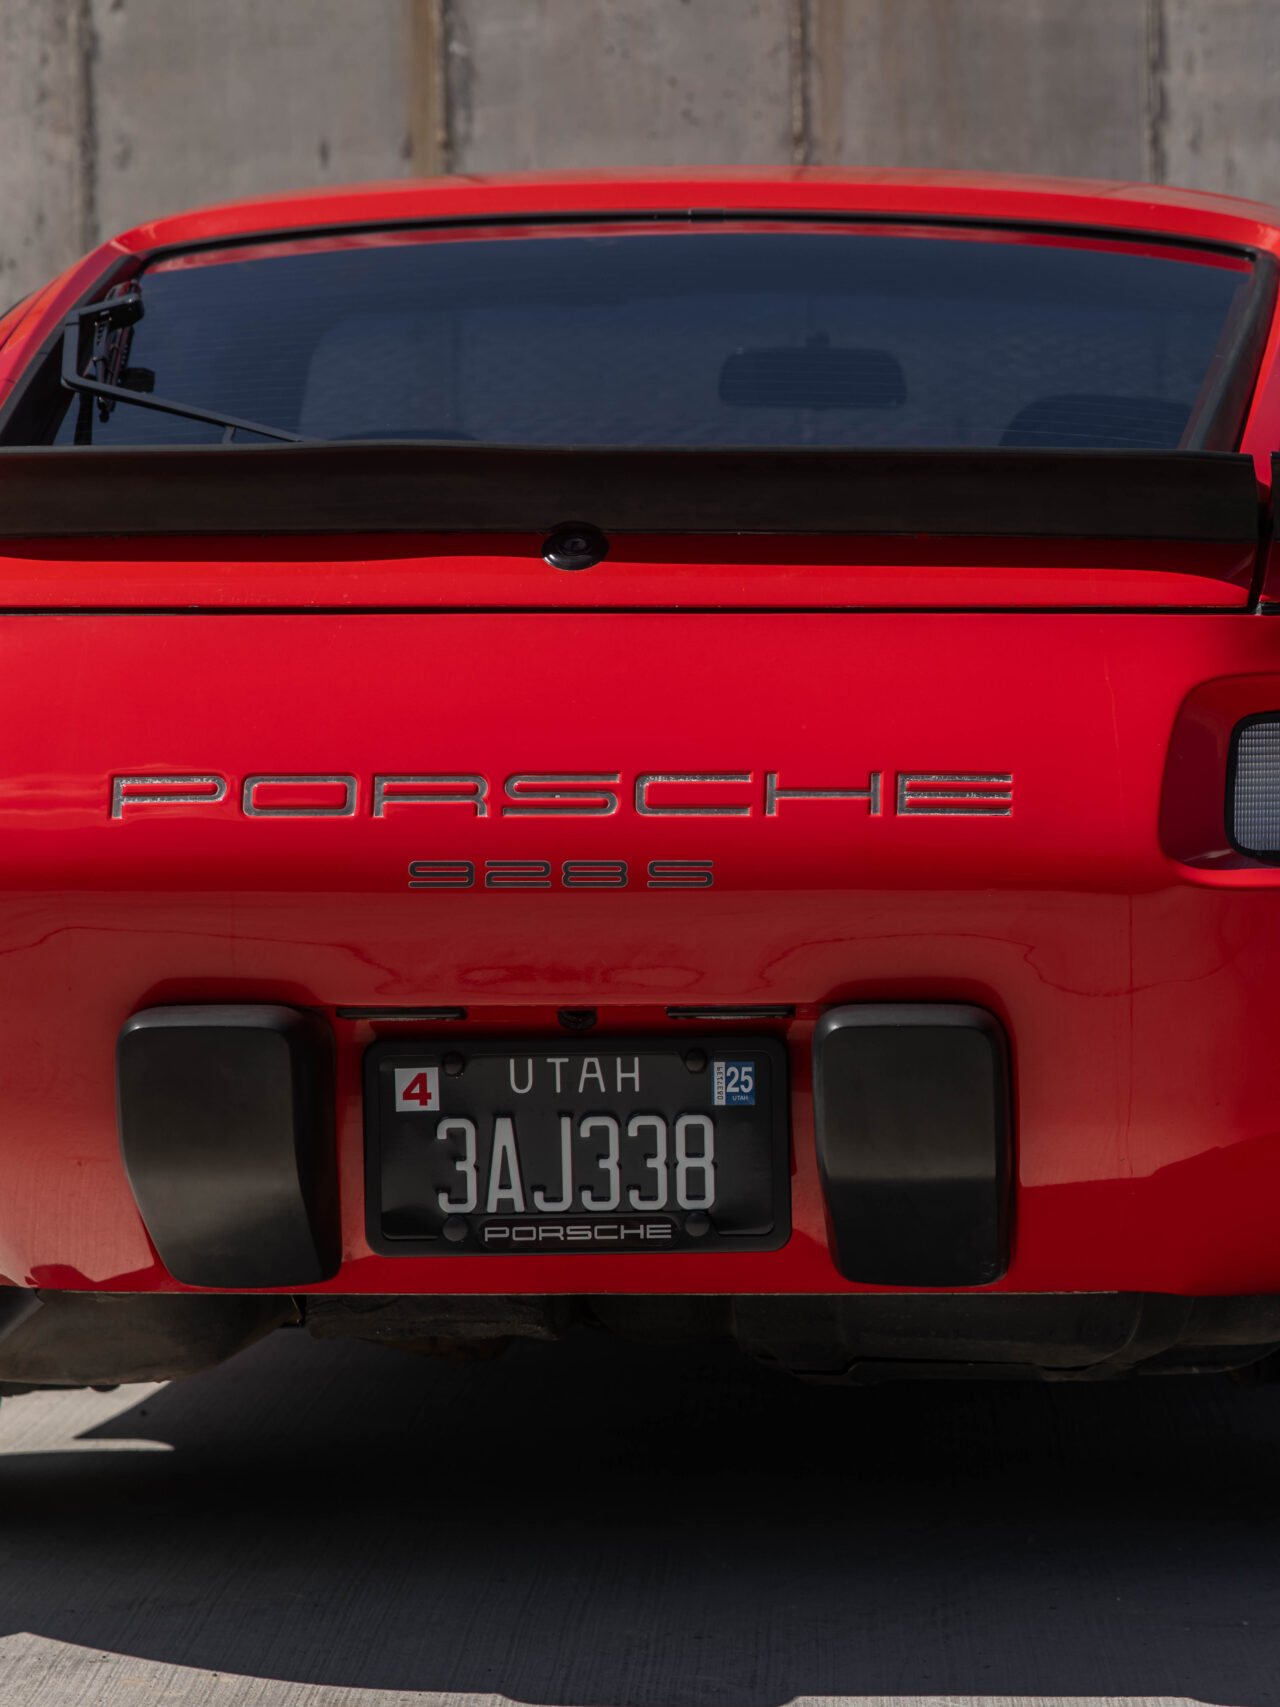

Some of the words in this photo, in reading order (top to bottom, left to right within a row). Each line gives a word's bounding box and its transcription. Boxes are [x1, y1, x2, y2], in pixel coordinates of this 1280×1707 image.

[112, 772, 1013, 819] PORSCHE
[407, 860, 628, 888] 928
[647, 860, 714, 888] S
[403, 1073, 431, 1106] 4
[509, 1057, 640, 1094] UTAH
[726, 1066, 754, 1093] 25
[437, 1114, 715, 1213] 3AJ338
[484, 1224, 672, 1242] PORSCHE
